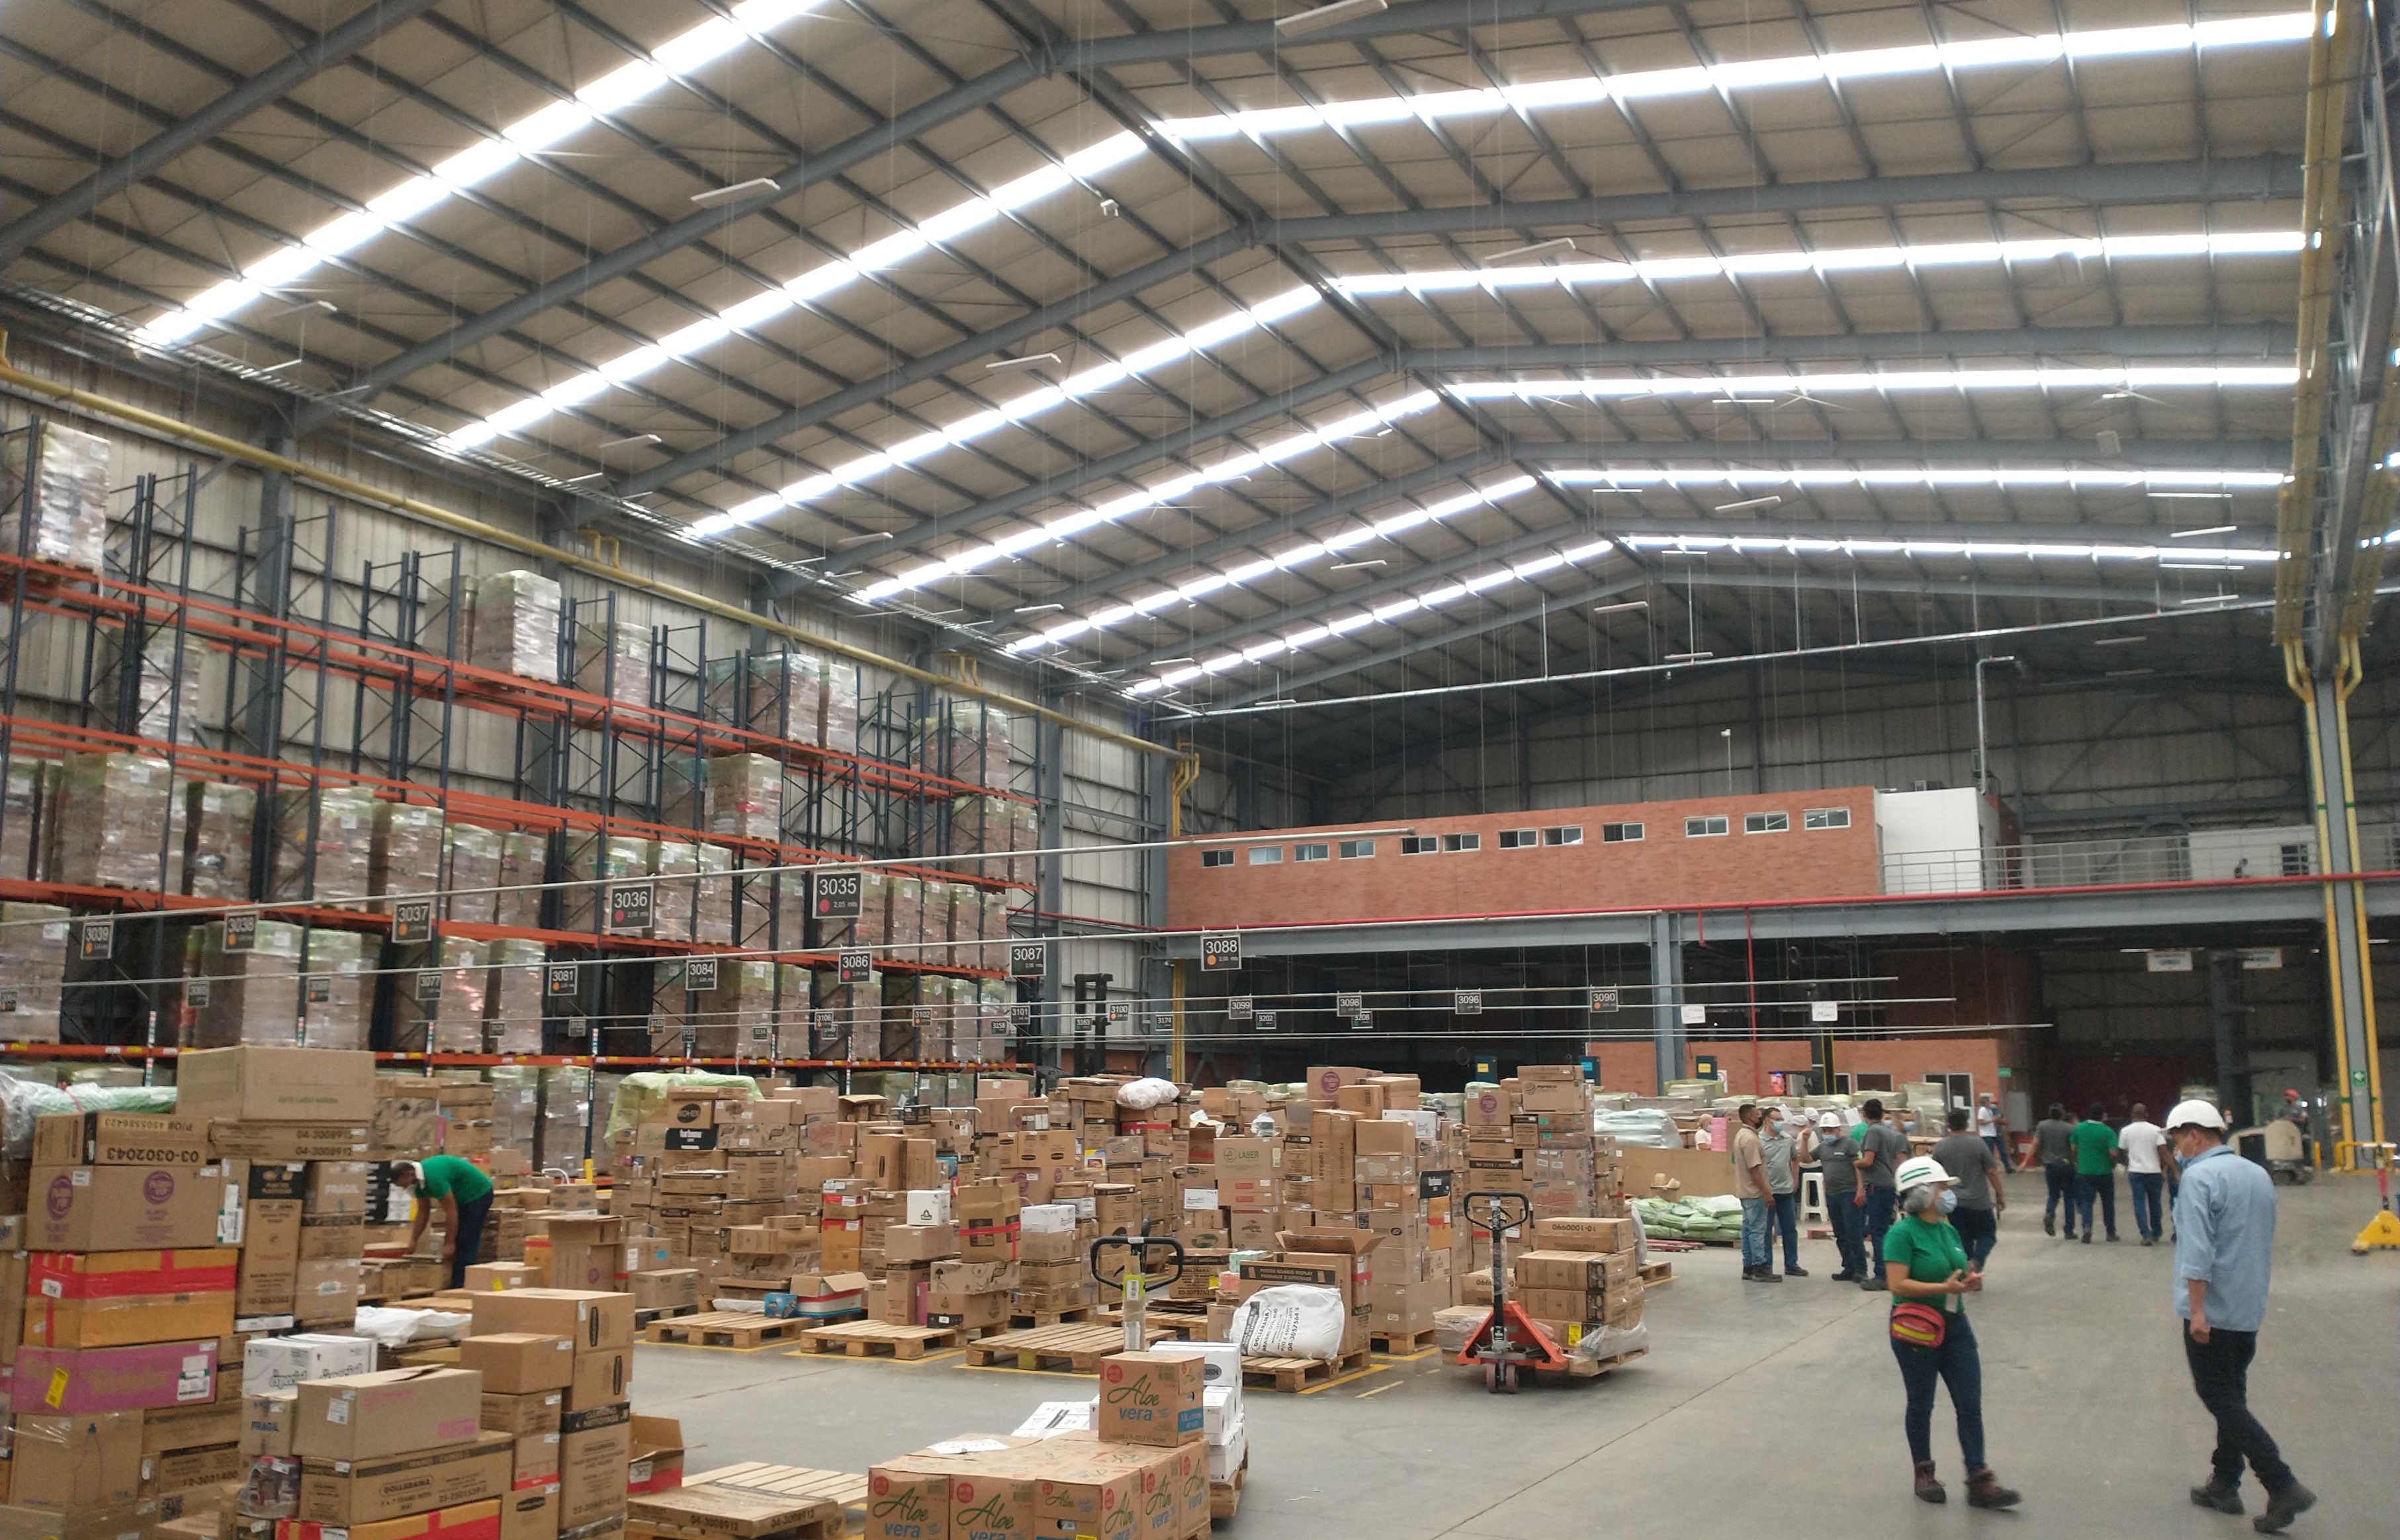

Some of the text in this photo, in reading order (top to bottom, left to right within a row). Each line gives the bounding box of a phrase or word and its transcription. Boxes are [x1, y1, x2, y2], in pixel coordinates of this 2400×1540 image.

[819, 877, 857, 895] 3035
[614, 891, 648, 908] 3036
[398, 906, 429, 922] 3037
[1206, 939, 1238, 954] 3088
[1014, 947, 1042, 961] 3087
[842, 955, 869, 968] 3086
[553, 970, 574, 982] 3081
[689, 963, 713, 976] 3084
[420, 975, 441, 987] 3077
[1339, 998, 1360, 1007] 3098
[1458, 995, 1480, 1004] 3096
[1593, 993, 1616, 1002] 3090
[817, 1013, 832, 1021] 3106
[1012, 1007, 1028, 1016] 3101
[107, 1147, 199, 1163] 03-0302043
[1254, 1312, 1270, 1348] DOLLARAMA
[1106, 1374, 1160, 1406] Aloe
[1119, 1407, 1153, 1421] vera
[1145, 1474, 1172, 1516] Aloe
[872, 1487, 929, 1521] Aloe
[956, 1493, 1015, 1529] Aloe
[1104, 1490, 1133, 1534] Aloe
[884, 1523, 921, 1539] vera
[969, 1530, 1006, 1540] vera
